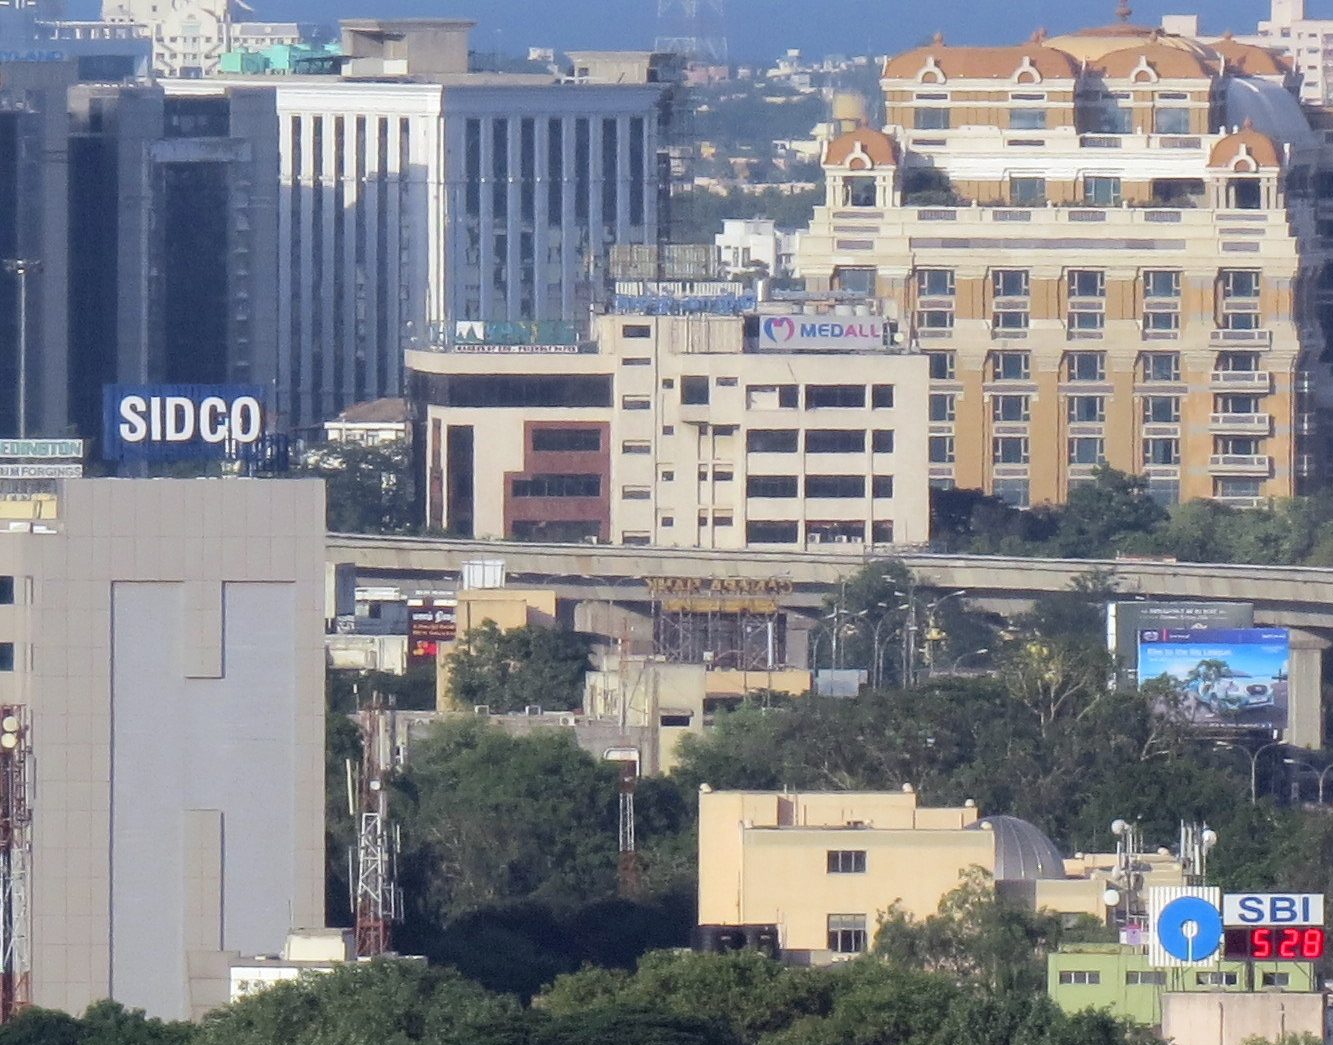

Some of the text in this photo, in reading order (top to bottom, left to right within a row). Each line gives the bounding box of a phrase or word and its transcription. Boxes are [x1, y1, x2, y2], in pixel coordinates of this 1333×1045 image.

[800, 323, 881, 338] MEDALL
[119, 395, 261, 443] SIDCO
[1238, 896, 1310, 923] SBI
